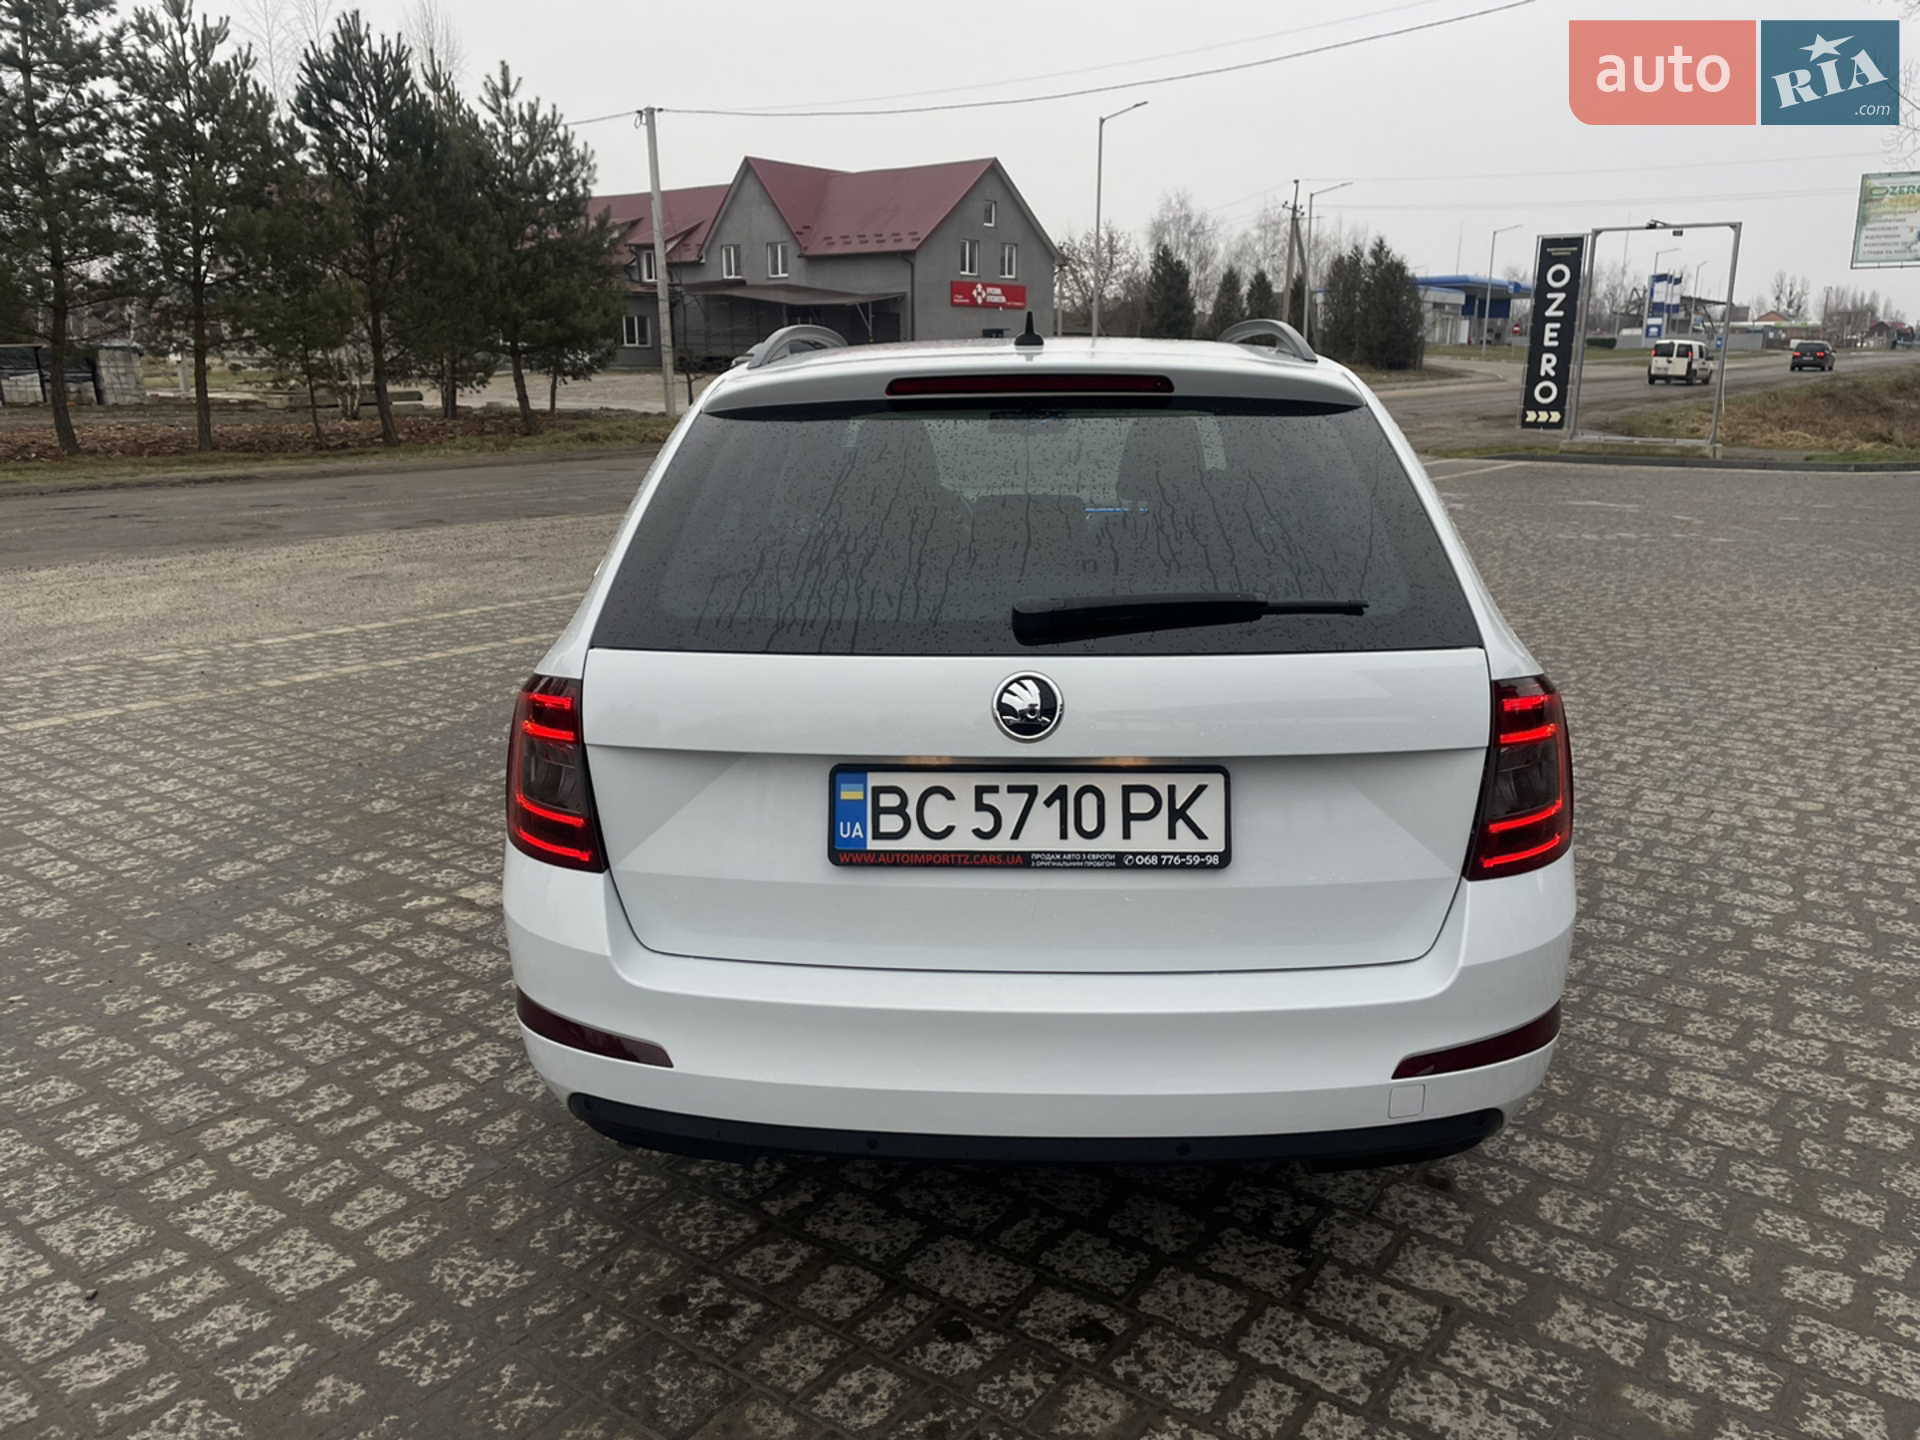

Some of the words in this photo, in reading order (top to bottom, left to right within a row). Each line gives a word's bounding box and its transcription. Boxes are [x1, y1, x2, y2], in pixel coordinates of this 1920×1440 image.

[1870, 185, 1920, 196] OZER
[1533, 263, 1572, 405] OZERO
[871, 785, 956, 841] BC
[971, 784, 1105, 841] 5710
[1121, 784, 1209, 840] PK
[839, 821, 864, 839] UA
[839, 852, 1023, 865] WWW.AUTOIMPORTTZ.CARS.UA
[1031, 853, 1061, 861] ПРОДАЖ
[1135, 854, 1158, 865] 068
[1160, 854, 1219, 866] 776-59-98
